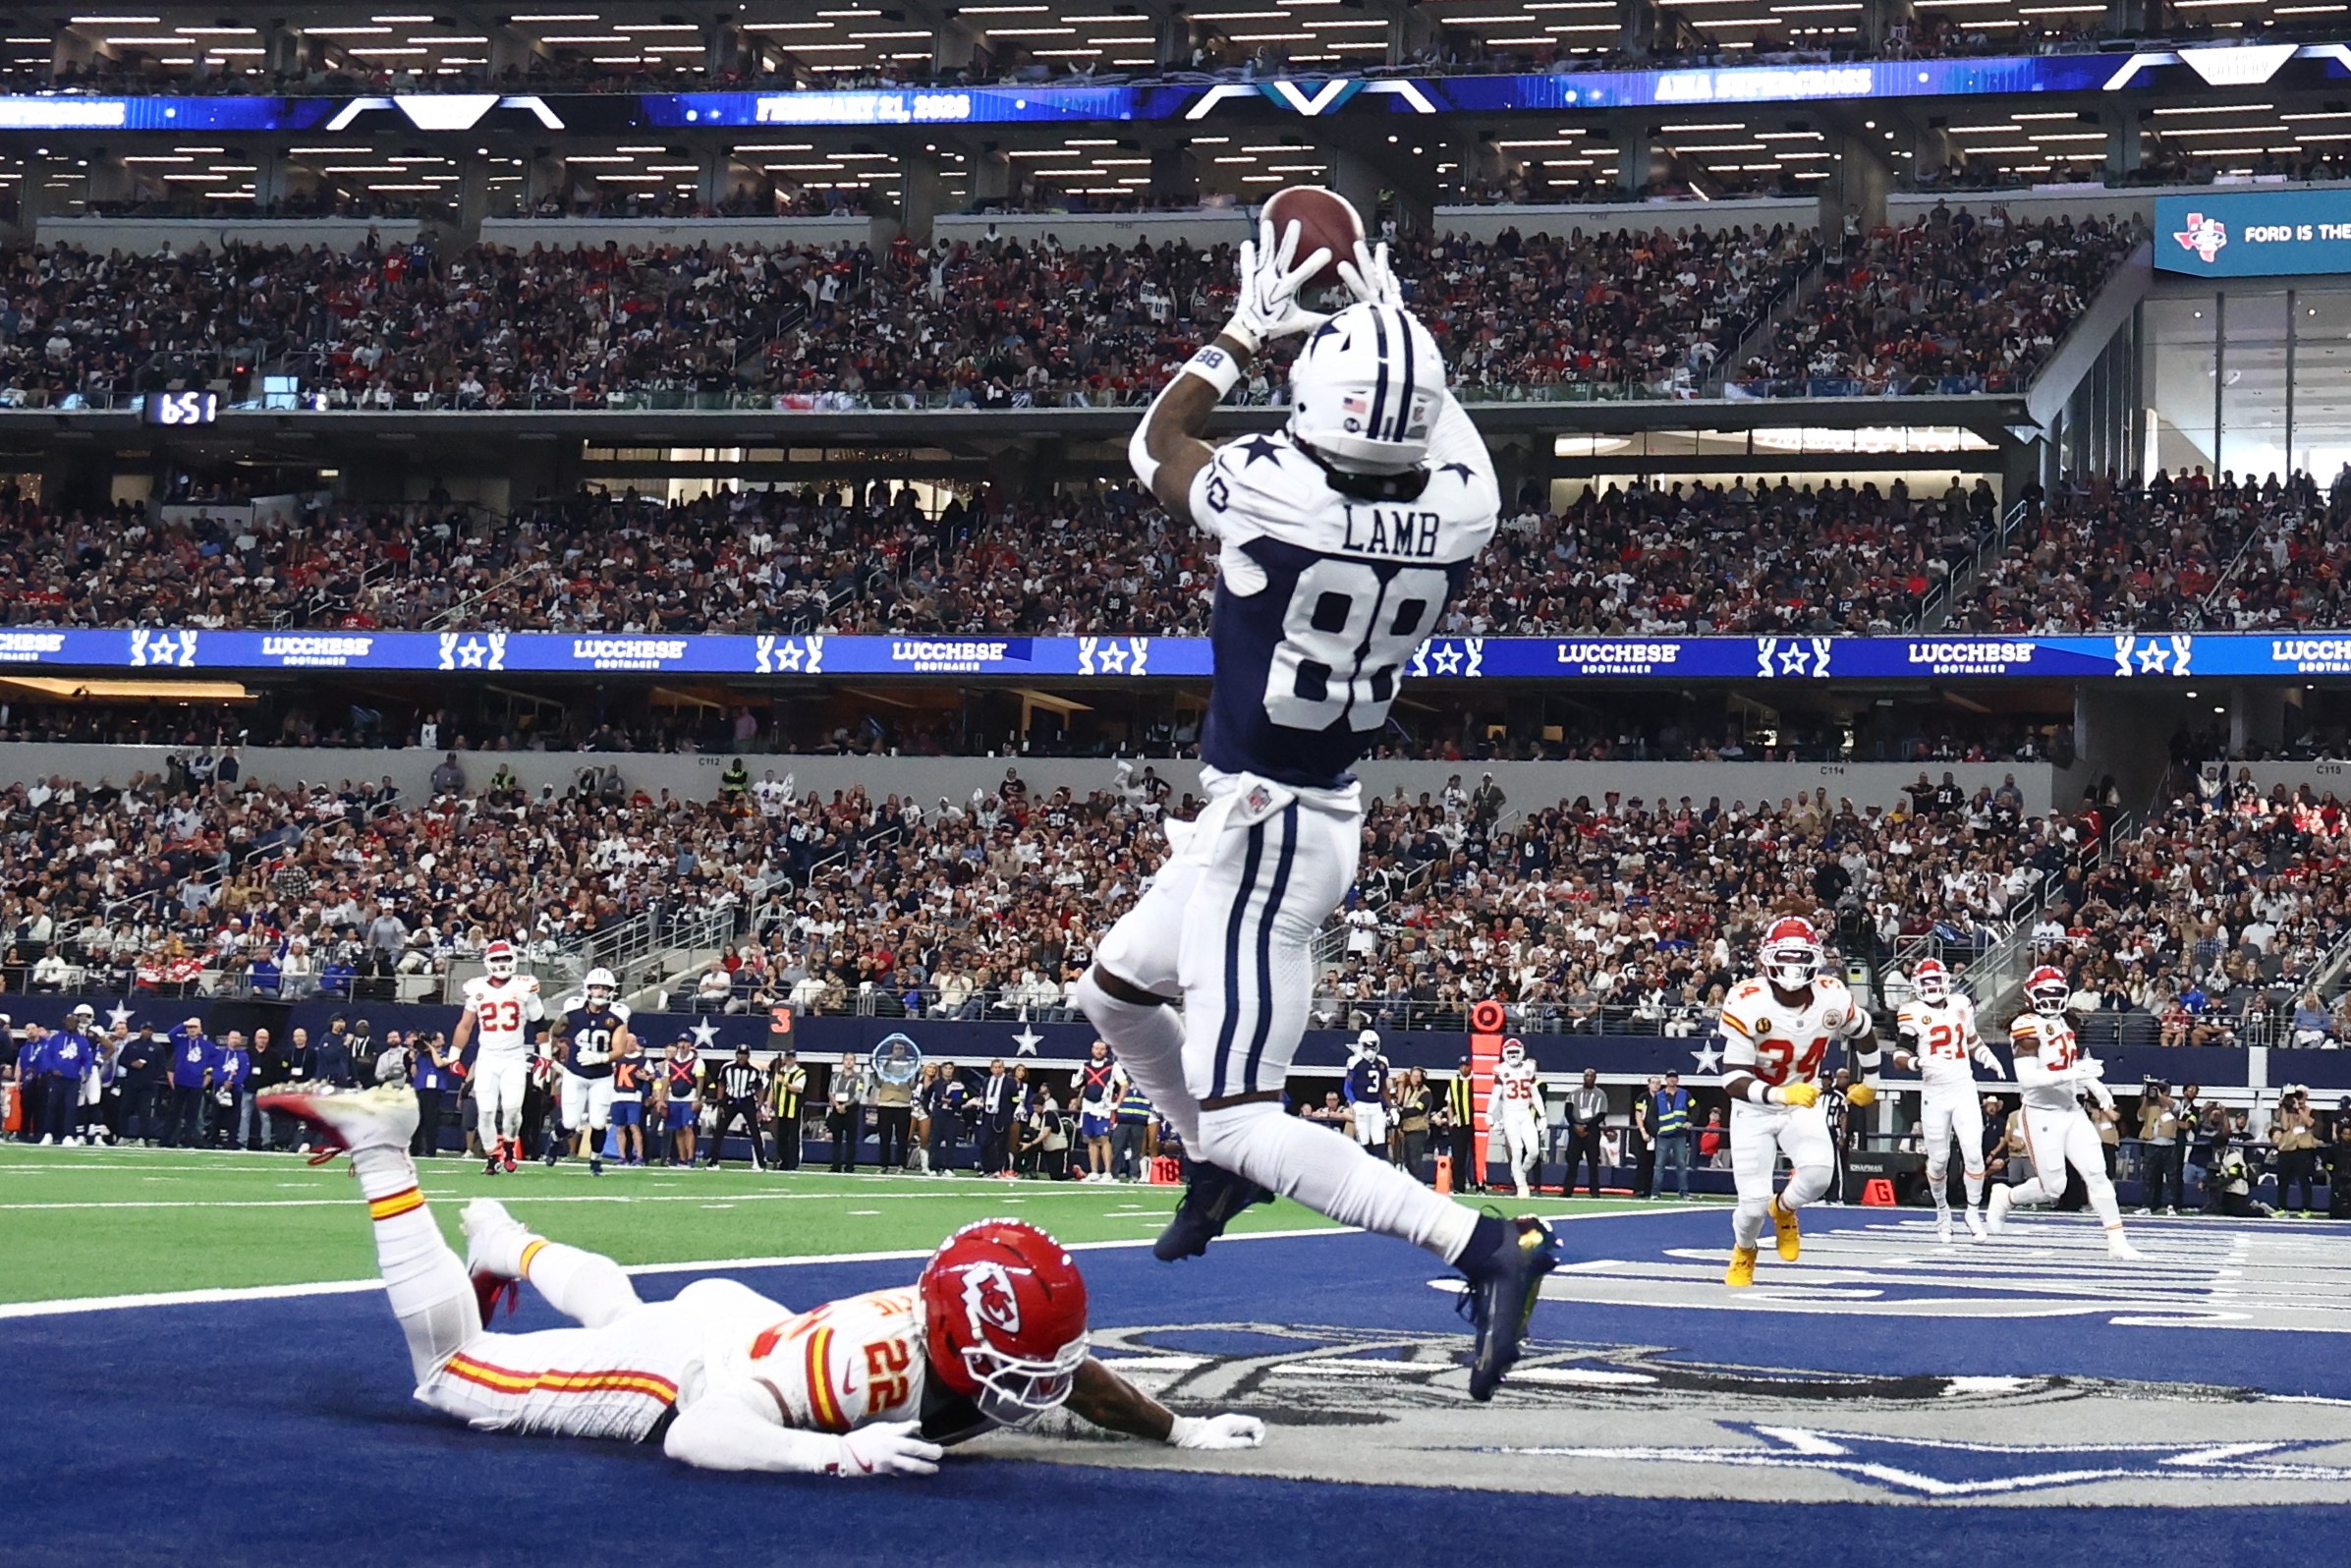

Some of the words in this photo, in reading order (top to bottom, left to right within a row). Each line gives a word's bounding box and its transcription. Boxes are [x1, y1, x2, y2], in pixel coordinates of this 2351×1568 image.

[1654, 75, 1712, 101] AMA
[1715, 69, 1873, 99] SUPERCROSS
[2245, 226, 2292, 243] FORD
[2297, 225, 2313, 242] IS
[2318, 223, 2351, 241] THE
[1195, 349, 1224, 370] 88
[1342, 504, 1440, 557] LAMB
[1839, 601, 1853, 613] 12
[263, 637, 369, 656] LUCCHESE
[574, 640, 684, 659] LUCCHESE
[892, 642, 1004, 661] LUCCHESE
[1261, 558, 1450, 733] 88
[1557, 644, 1677, 663] LUCCHESE
[1909, 644, 2032, 663] LUCCHESE
[2272, 641, 2351, 661] LUCCH
[283, 656, 347, 666] BOOTMAKER
[594, 659, 660, 669] BOOTMAKER
[914, 661, 980, 672] BOOTMAKER
[1581, 664, 1651, 675] BOOTMAKER
[1932, 664, 2006, 674] BOOTMAKER
[699, 757, 720, 766] C112
[1820, 766, 1845, 776] C114
[2316, 766, 2342, 775] C115
[609, 850, 617, 862] 4
[480, 1001, 520, 1032] 23
[770, 1008, 791, 1034] 3
[1930, 1024, 1965, 1060] 21
[1754, 1036, 1829, 1086] 34
[617, 1063, 638, 1088] K
[1367, 1070, 1380, 1093] 3
[1506, 1080, 1532, 1099] 35
[1849, 1163, 1883, 1173] CHAPMAN
[1875, 1182, 1890, 1203] G
[863, 1337, 911, 1415] 22
